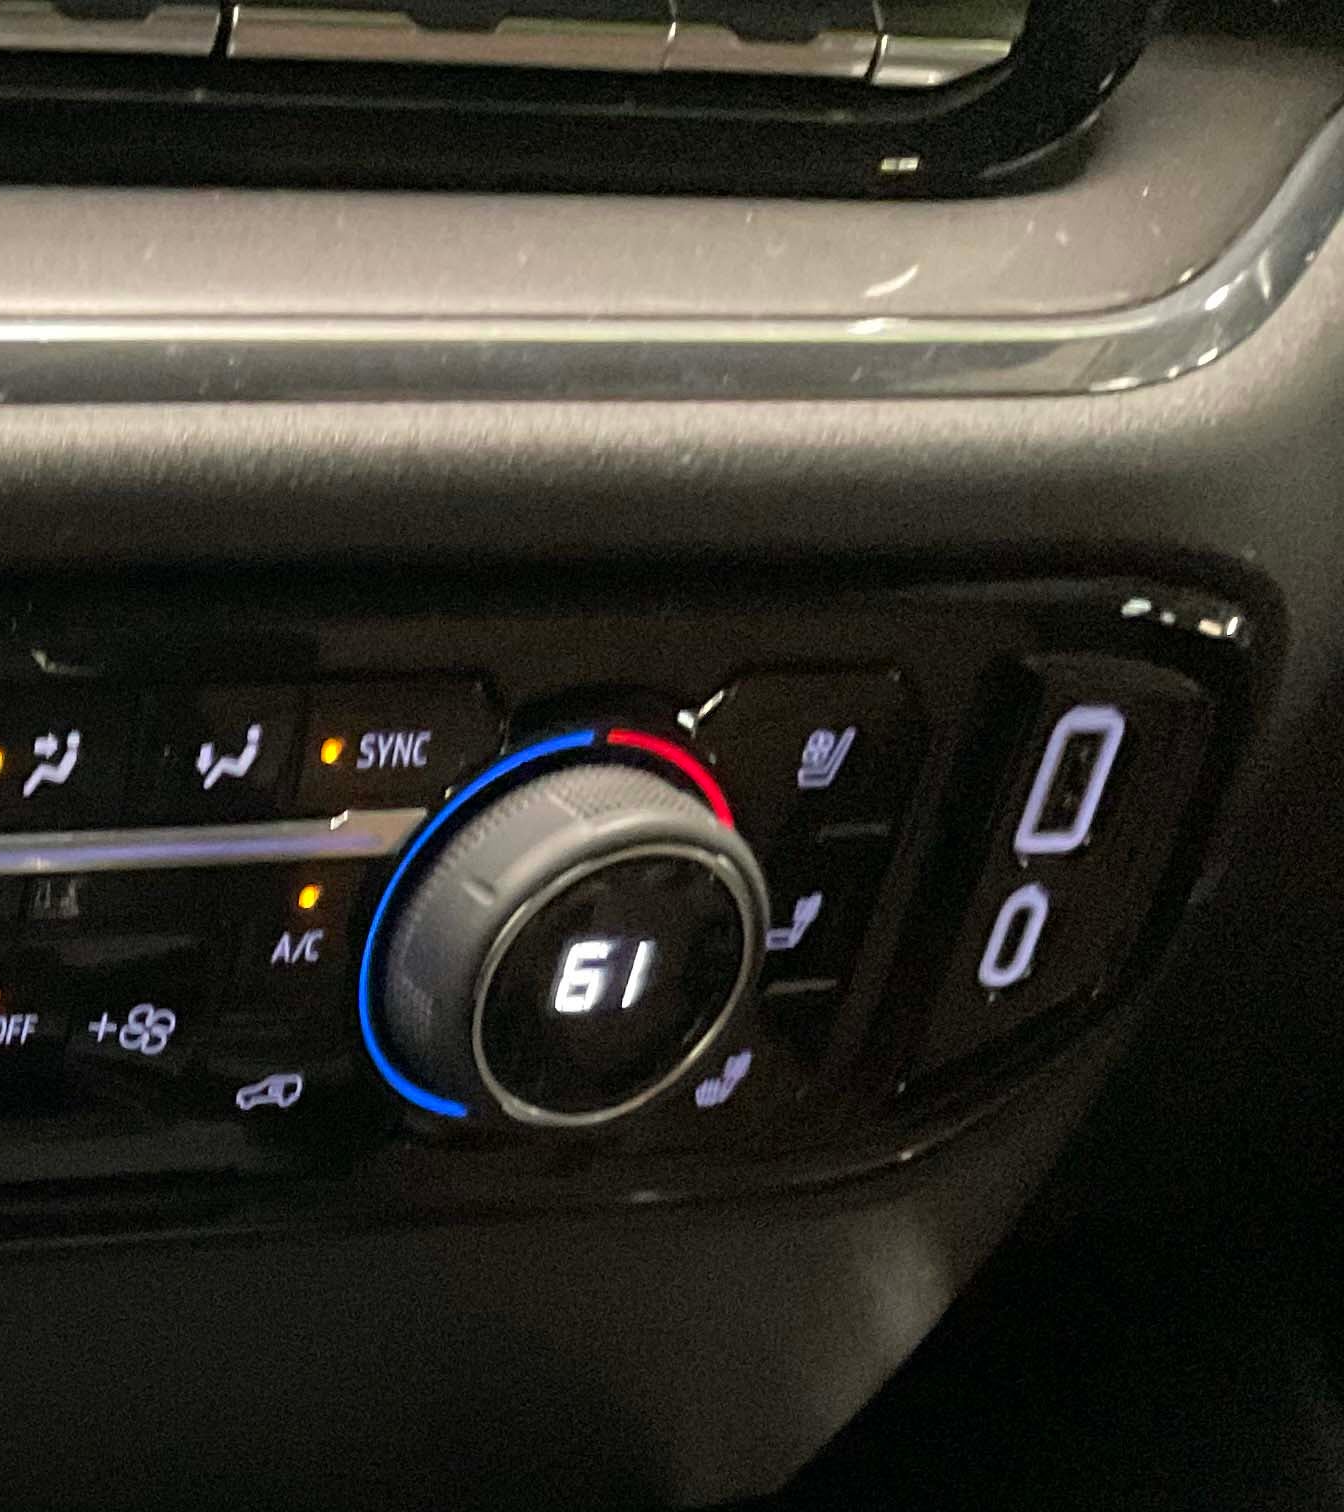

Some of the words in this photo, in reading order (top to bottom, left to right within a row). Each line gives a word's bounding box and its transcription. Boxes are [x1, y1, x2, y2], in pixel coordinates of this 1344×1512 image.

[356, 728, 433, 771] SYNC
[271, 929, 325, 965] A/C
[554, 940, 656, 1015] 61
